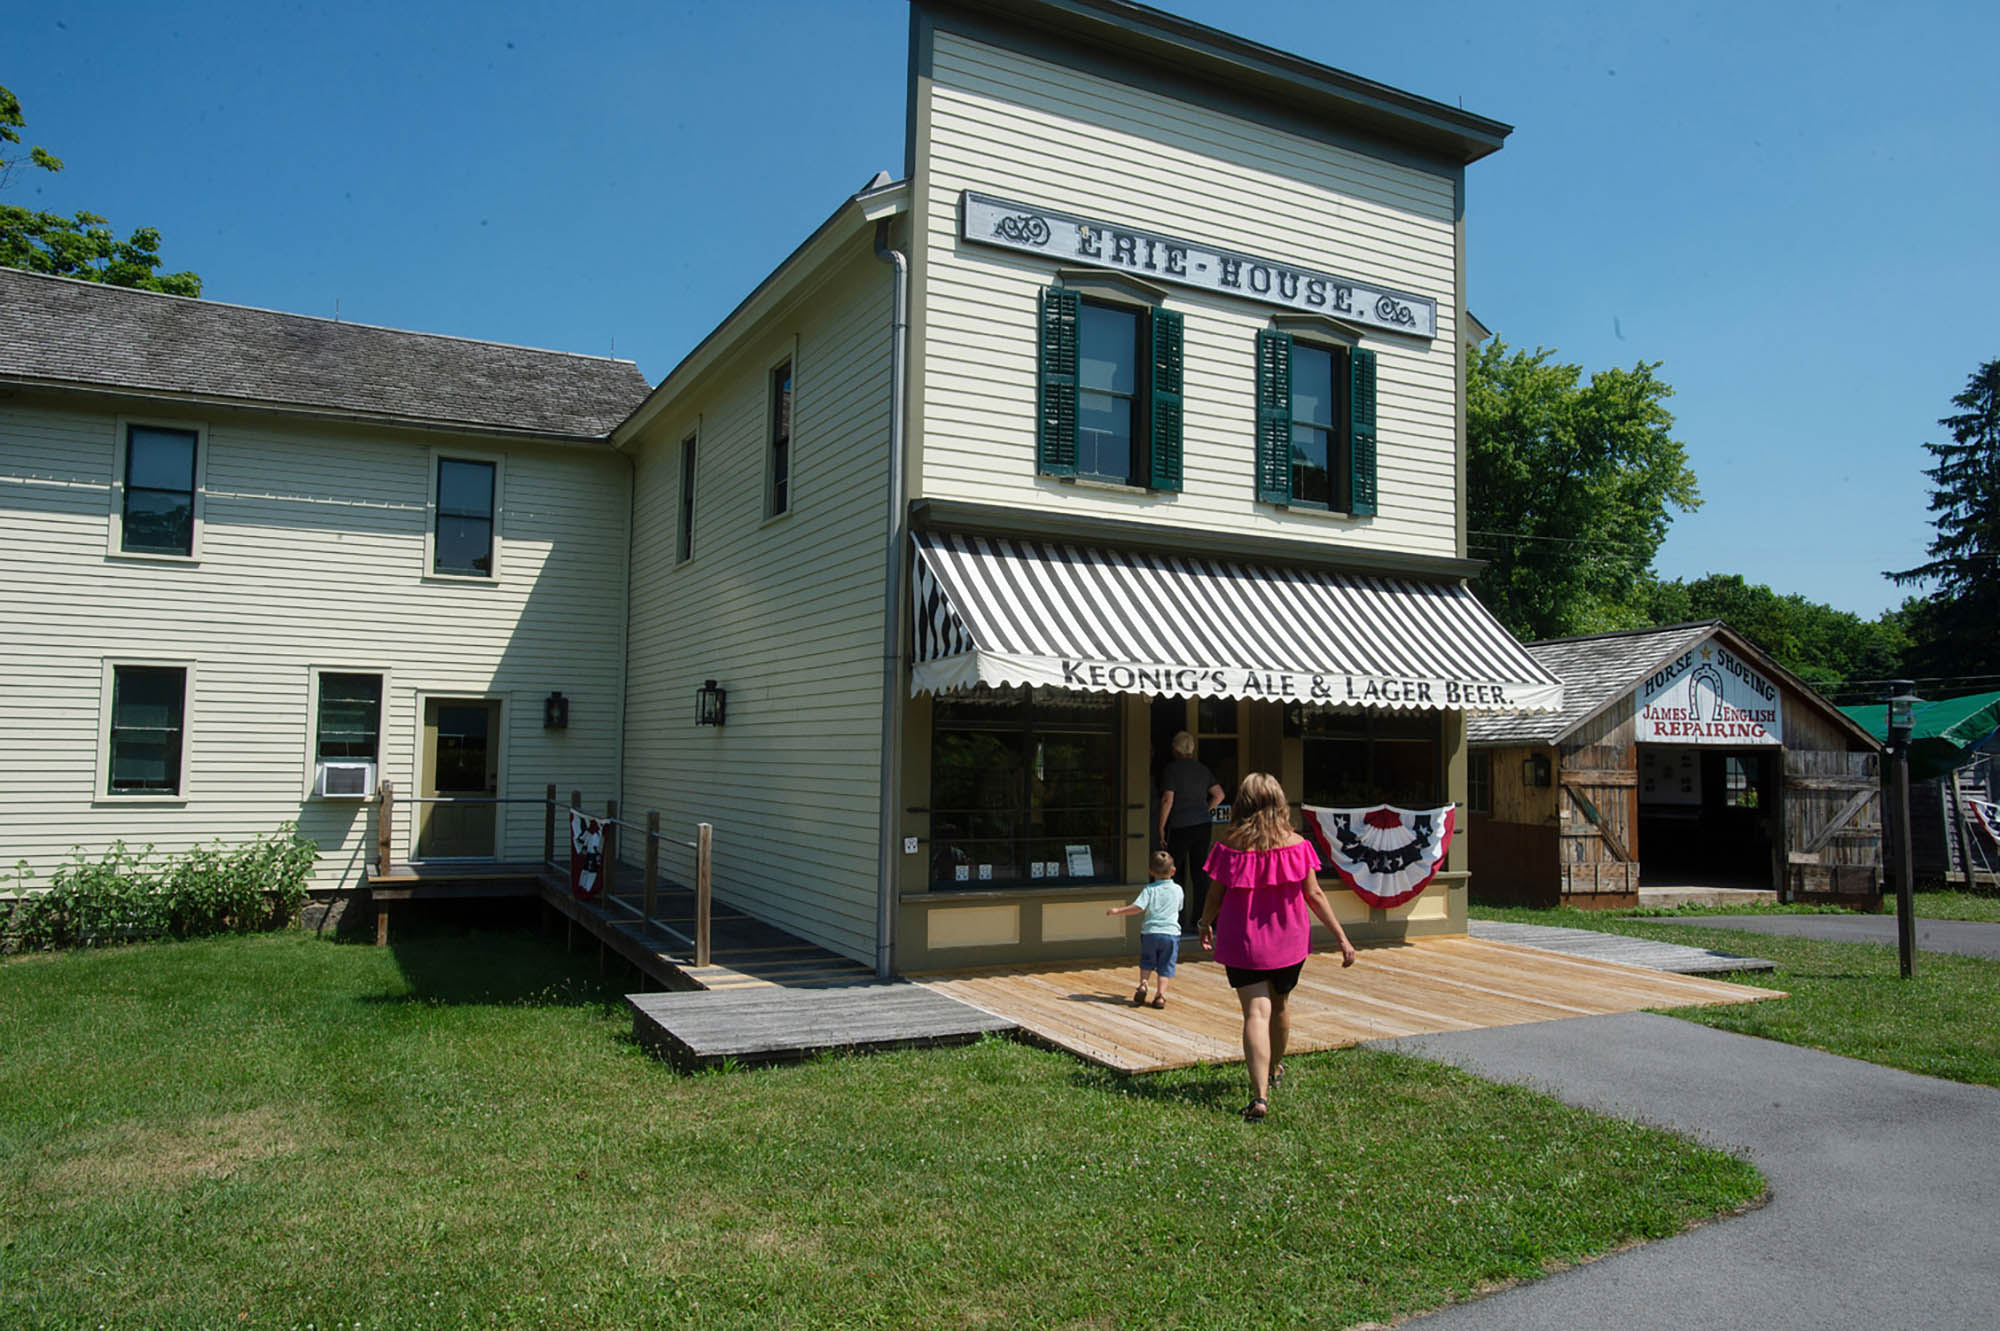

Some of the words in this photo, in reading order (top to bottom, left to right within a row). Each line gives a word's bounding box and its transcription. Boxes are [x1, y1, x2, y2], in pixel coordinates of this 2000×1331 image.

[1062, 660, 1228, 692] KEONIG'S
[1242, 671, 1295, 697] ALE
[1310, 674, 1332, 699] &
[1346, 676, 1431, 704] LAGER
[1445, 680, 1515, 705] BEER.
[1645, 651, 1692, 697] HORSE
[1717, 649, 1775, 701] SHOEING
[1642, 704, 1687, 720] JAMES
[1723, 706, 1776, 722] ENGLISH
[1653, 721, 1767, 738] REPAIRING
[1209, 807, 1230, 820] PEN
